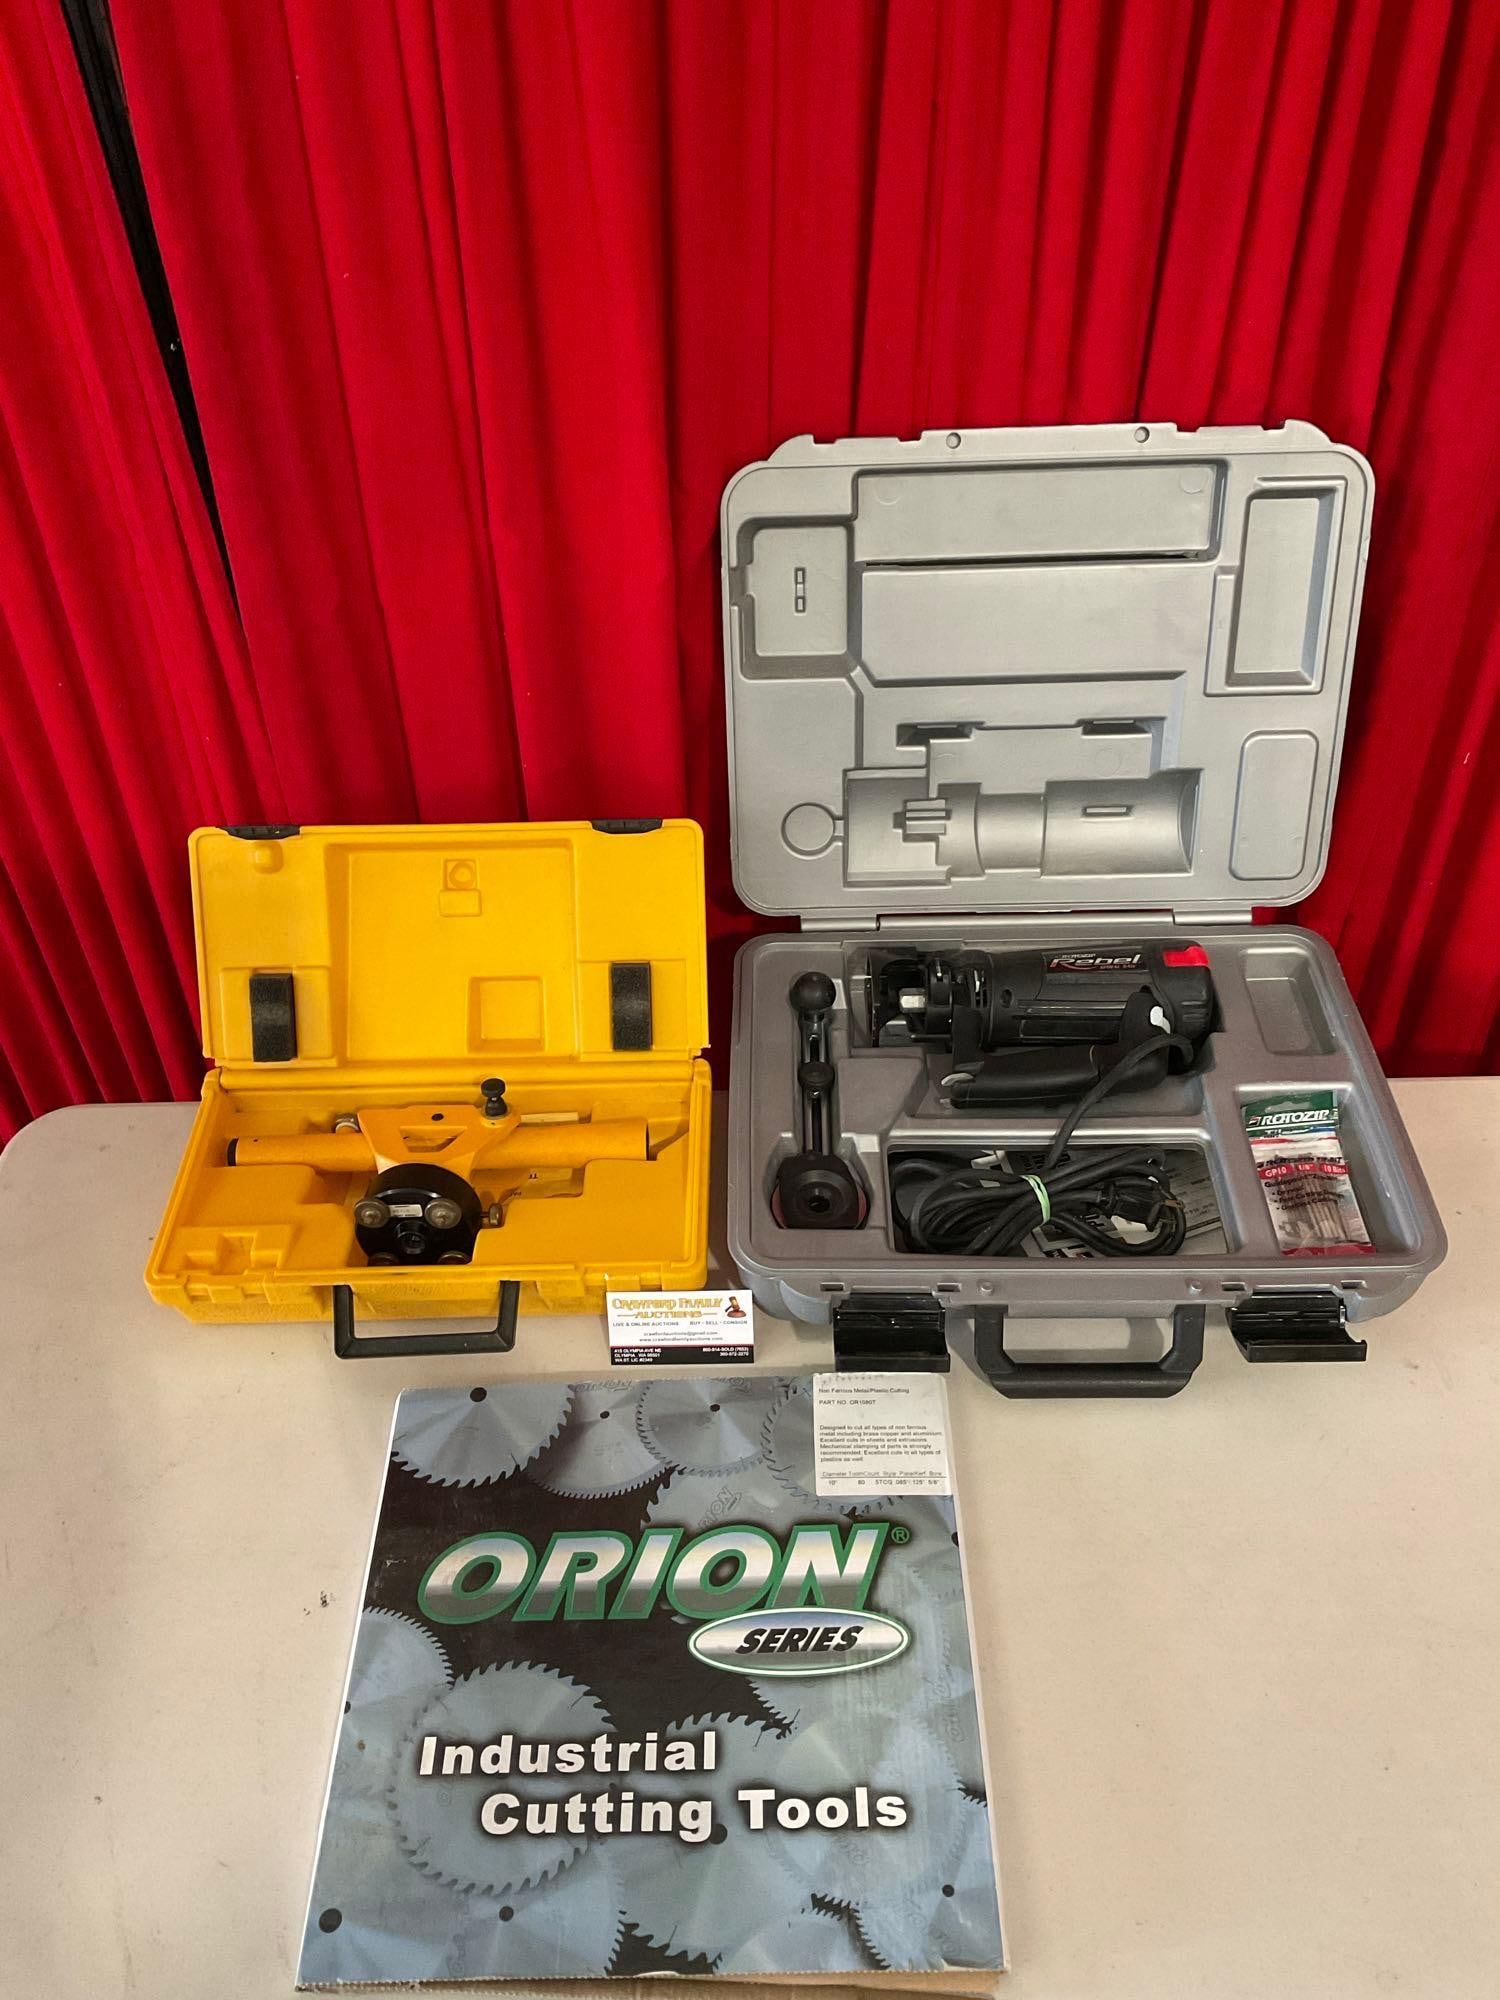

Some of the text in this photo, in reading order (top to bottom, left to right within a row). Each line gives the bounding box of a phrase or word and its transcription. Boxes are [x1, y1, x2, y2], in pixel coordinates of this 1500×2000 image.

[1050, 954, 1141, 968] Rebel
[1261, 1109, 1330, 1126] ROTOZIP
[1264, 1166, 1287, 1178] GP10
[634, 1310, 702, 1319] AUCTIONS
[418, 1522, 890, 1625] ORION
[735, 1624, 864, 1655] SERIES
[419, 1730, 717, 1776] Industrial
[480, 1786, 908, 1843] Cutting Tools
